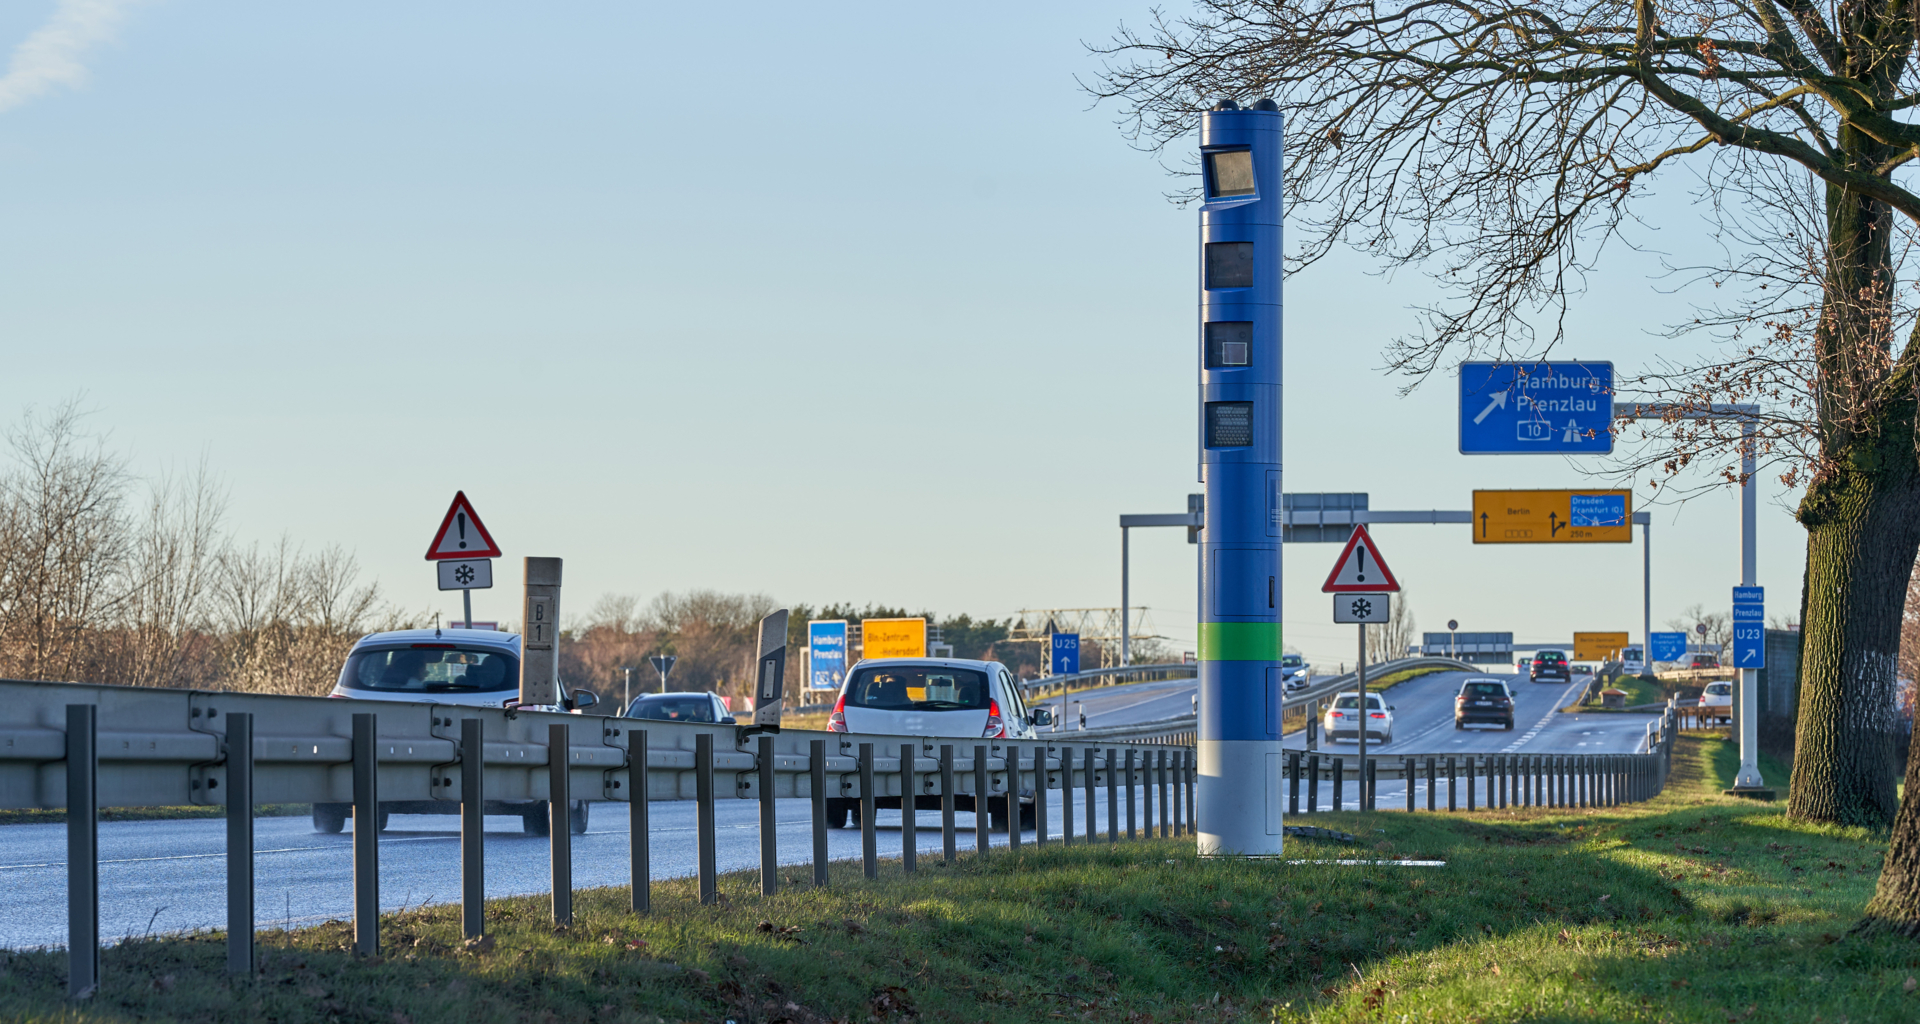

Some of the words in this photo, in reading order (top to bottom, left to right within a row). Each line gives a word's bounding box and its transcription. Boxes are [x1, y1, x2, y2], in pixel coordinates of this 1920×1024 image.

[1517, 373, 1600, 393] Hamburg
[1517, 396, 1597, 411] Prenzlau
[1527, 424, 1541, 436] 10
[1572, 497, 1605, 505] Dresden
[1572, 506, 1608, 514] Frankfurt
[1735, 591, 1762, 601] Hamburg
[536, 604, 543, 620] B
[1735, 609, 1762, 617] Prenzlau
[536, 624, 541, 641] 1
[1736, 629, 1745, 640] U
[1746, 628, 1760, 640] 23
[813, 635, 843, 647] Hamburg
[1055, 639, 1063, 649] U
[1064, 639, 1077, 649] 25
[813, 650, 843, 659] Prenzlau
